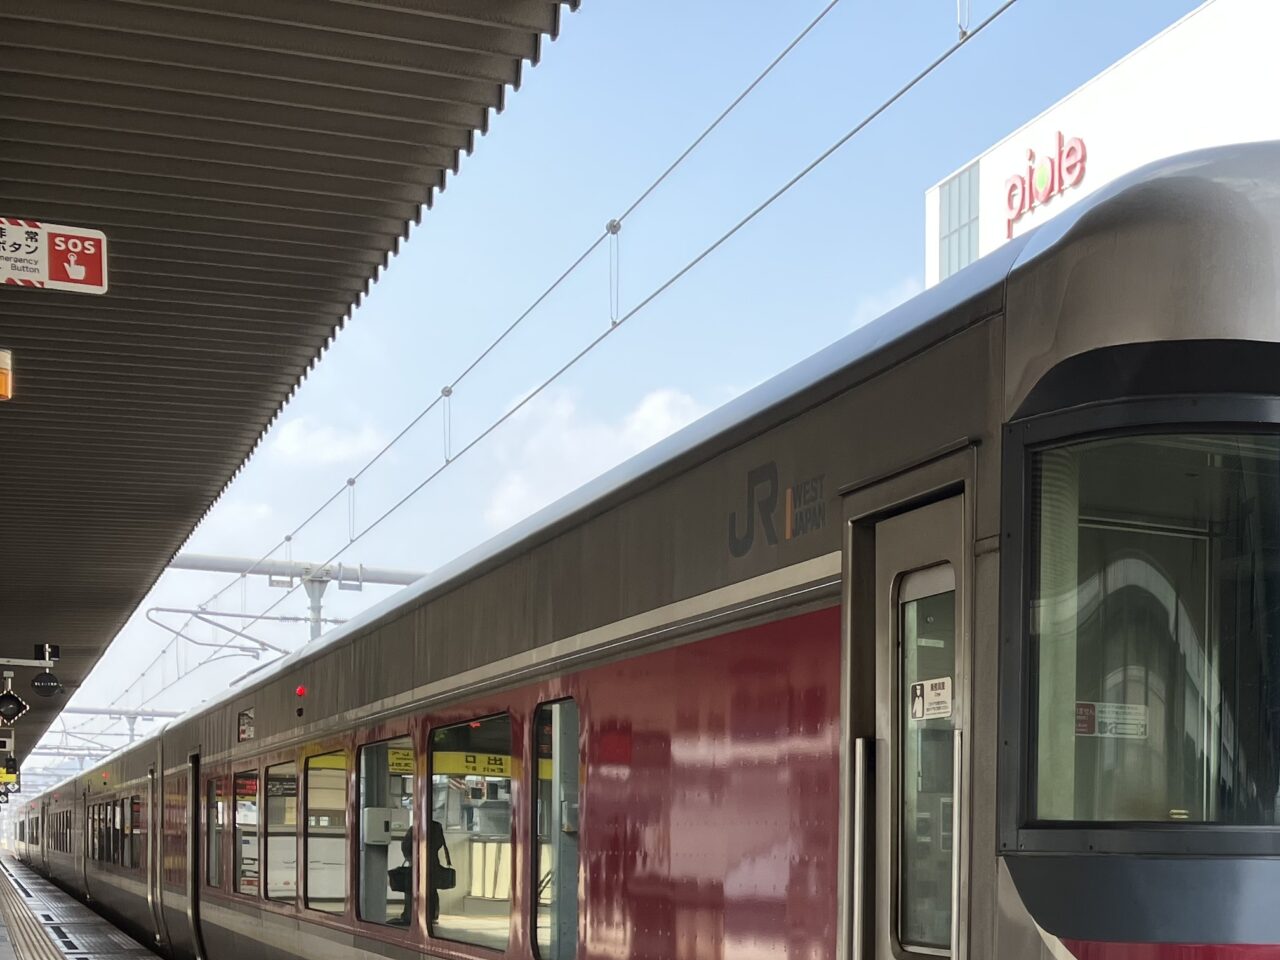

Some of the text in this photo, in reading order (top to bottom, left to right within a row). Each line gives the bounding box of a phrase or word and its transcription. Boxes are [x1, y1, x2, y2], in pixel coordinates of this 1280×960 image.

[1004, 130, 1087, 239] piole
[54, 237, 95, 254] SOS
[10, 263, 40, 273] Button
[728, 460, 778, 558] JR
[792, 474, 827, 512] WEST
[792, 502, 827, 539] JAPAN
